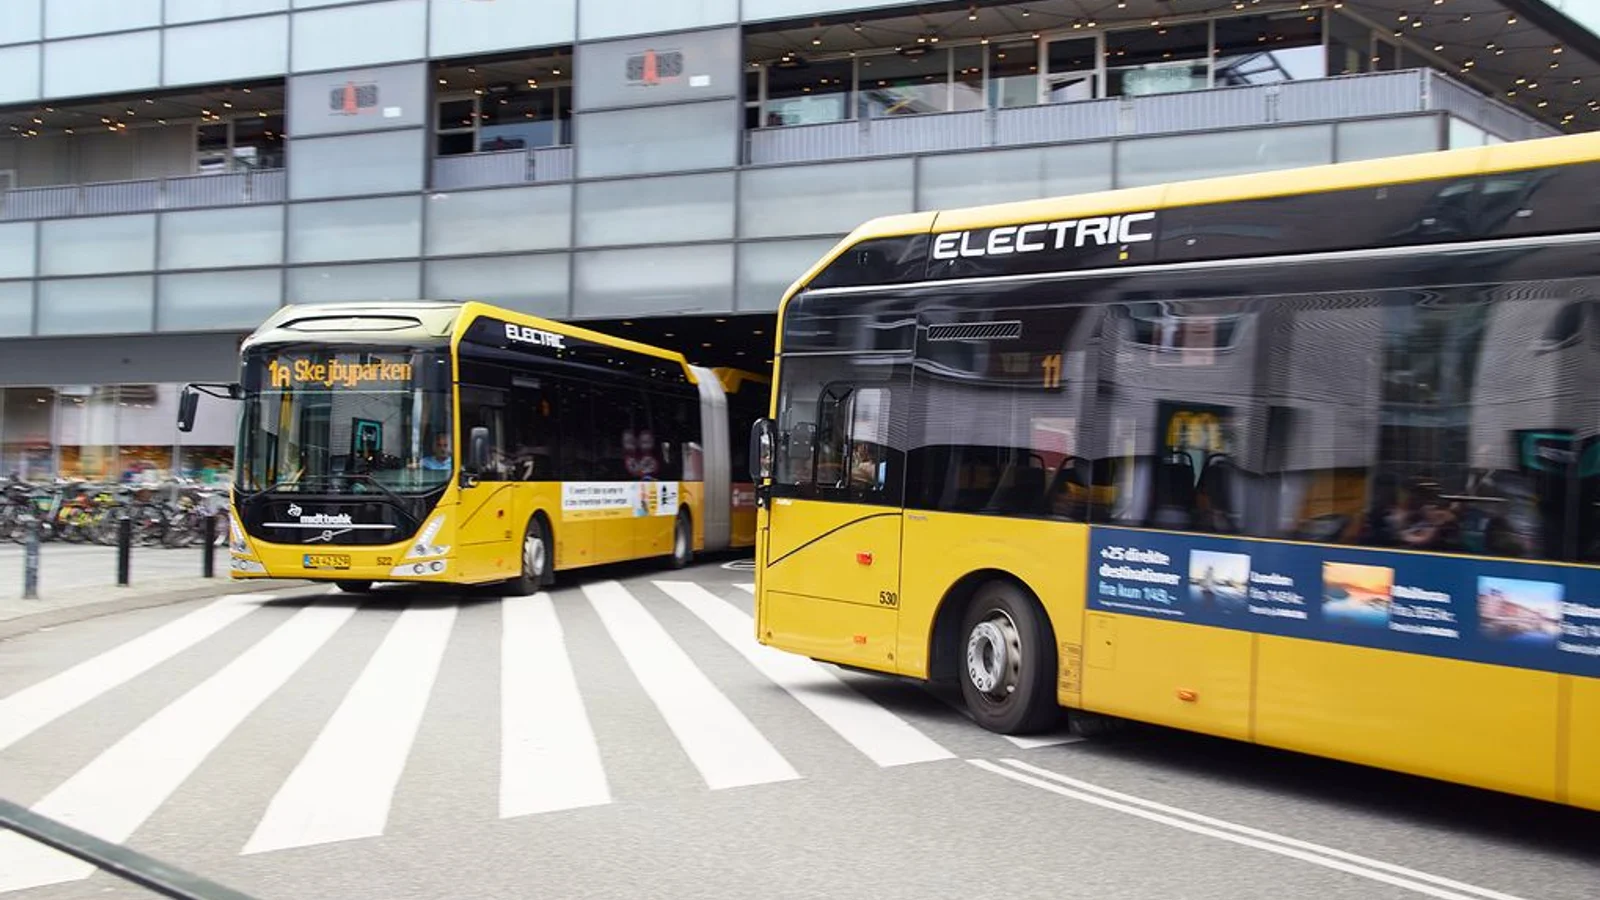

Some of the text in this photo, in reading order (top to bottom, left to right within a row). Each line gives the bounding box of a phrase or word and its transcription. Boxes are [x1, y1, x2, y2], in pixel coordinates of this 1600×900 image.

[933, 211, 1156, 260] ELECTRIC
[505, 323, 566, 349] ELECTRIC
[269, 360, 290, 387] 1A
[1041, 354, 1062, 388] 11
[1125, 547, 1170, 566] direkte
[1099, 563, 1181, 585] destinationer
[879, 591, 897, 606] 530
